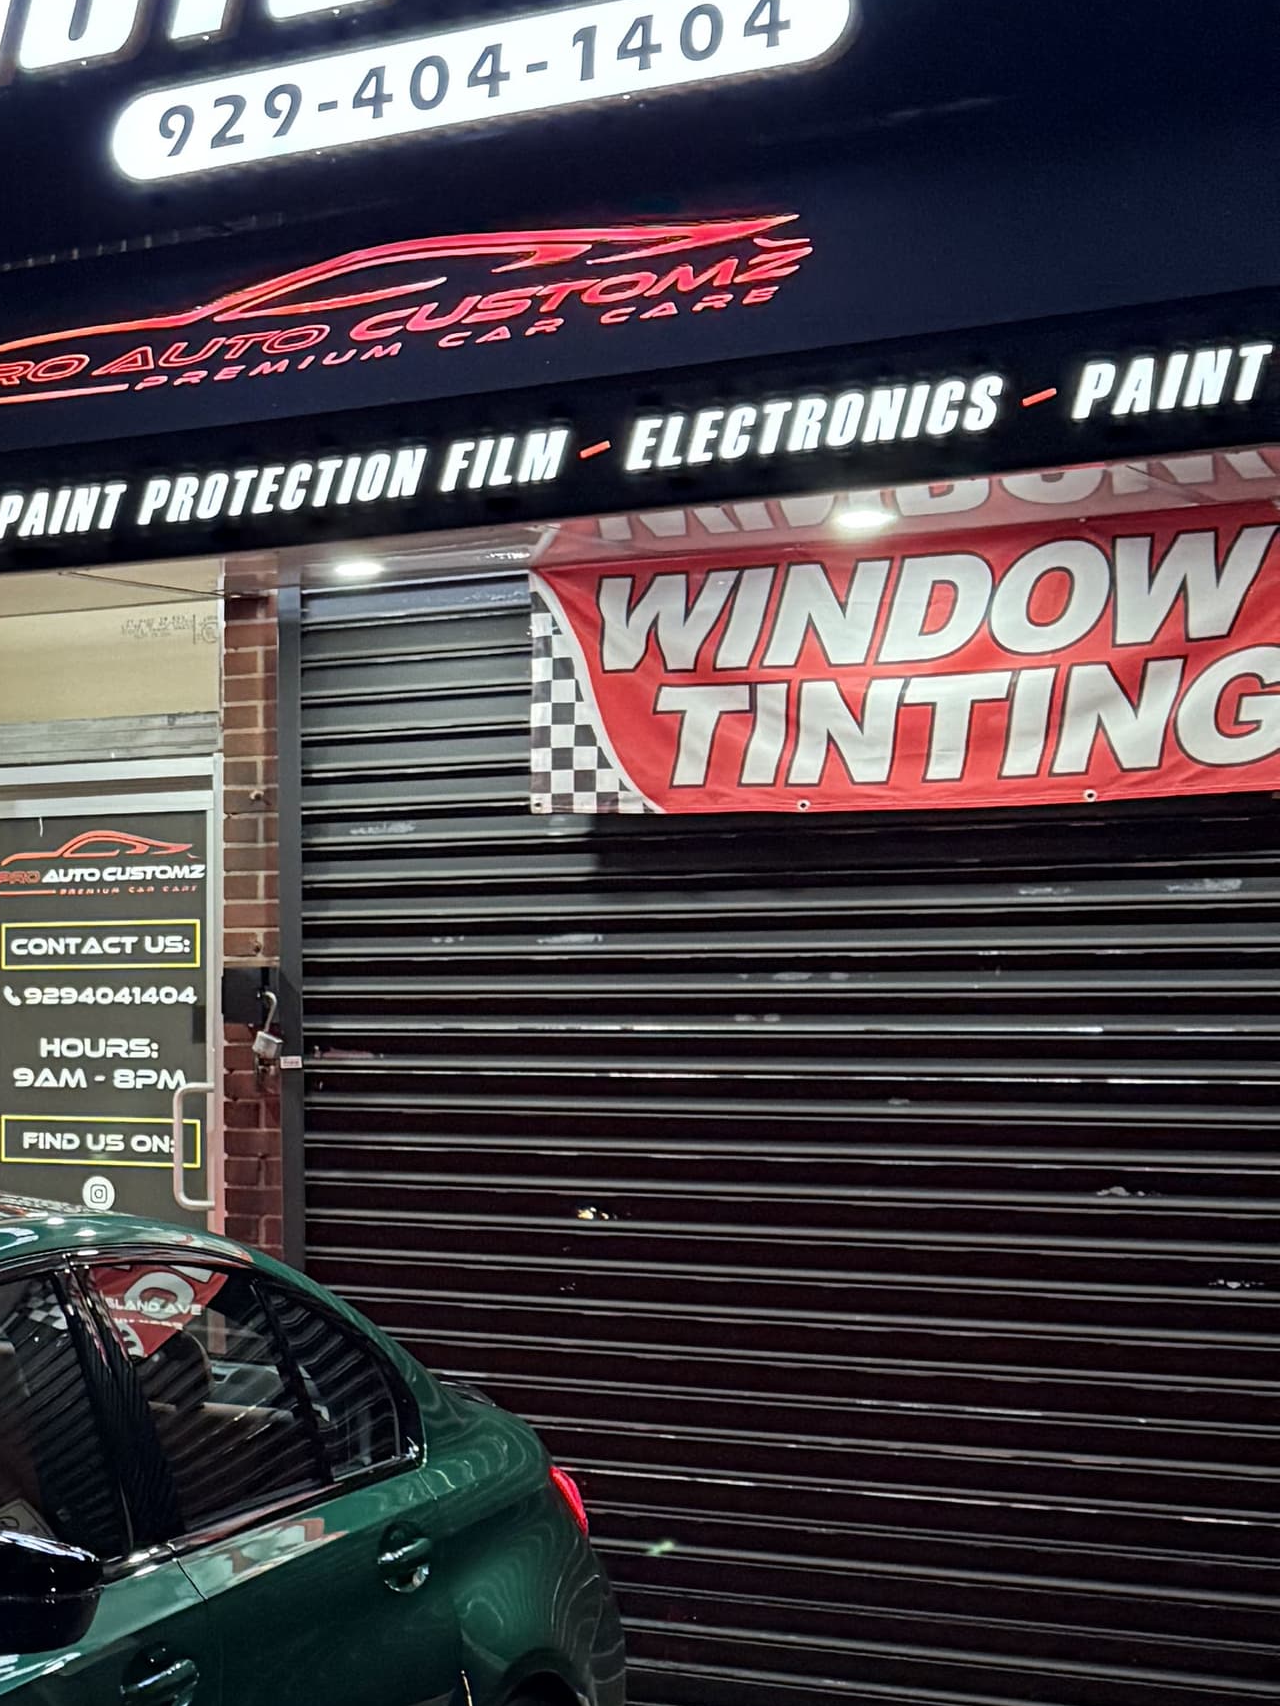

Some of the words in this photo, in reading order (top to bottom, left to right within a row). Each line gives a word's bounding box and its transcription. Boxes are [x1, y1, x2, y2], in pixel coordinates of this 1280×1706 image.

[91, 324, 331, 376] AUTO
[348, 243, 813, 342] CUSTOMZ
[135, 341, 403, 391] PREMIUM
[438, 317, 564, 348] CAR
[600, 286, 780, 325] CARE
[137, 447, 428, 526] PROTECTION
[440, 429, 569, 493] FILM
[625, 375, 1006, 472] ELECTRONICS
[1071, 343, 1273, 420] PAINT
[598, 524, 1280, 673] WINDOW
[651, 646, 1280, 787] TINTING
[42, 868, 102, 883] AUTO
[102, 864, 206, 881] CUSTOMZ
[10, 936, 138, 957] CONTACT
[144, 936, 191, 955] US:
[24, 986, 198, 1006] 9294041404
[40, 1038, 159, 1059] HOURS:
[12, 1068, 87, 1089] 9AM
[112, 1069, 188, 1091] 8PM
[22, 1132, 80, 1152] FIND
[86, 1133, 125, 1153] US
